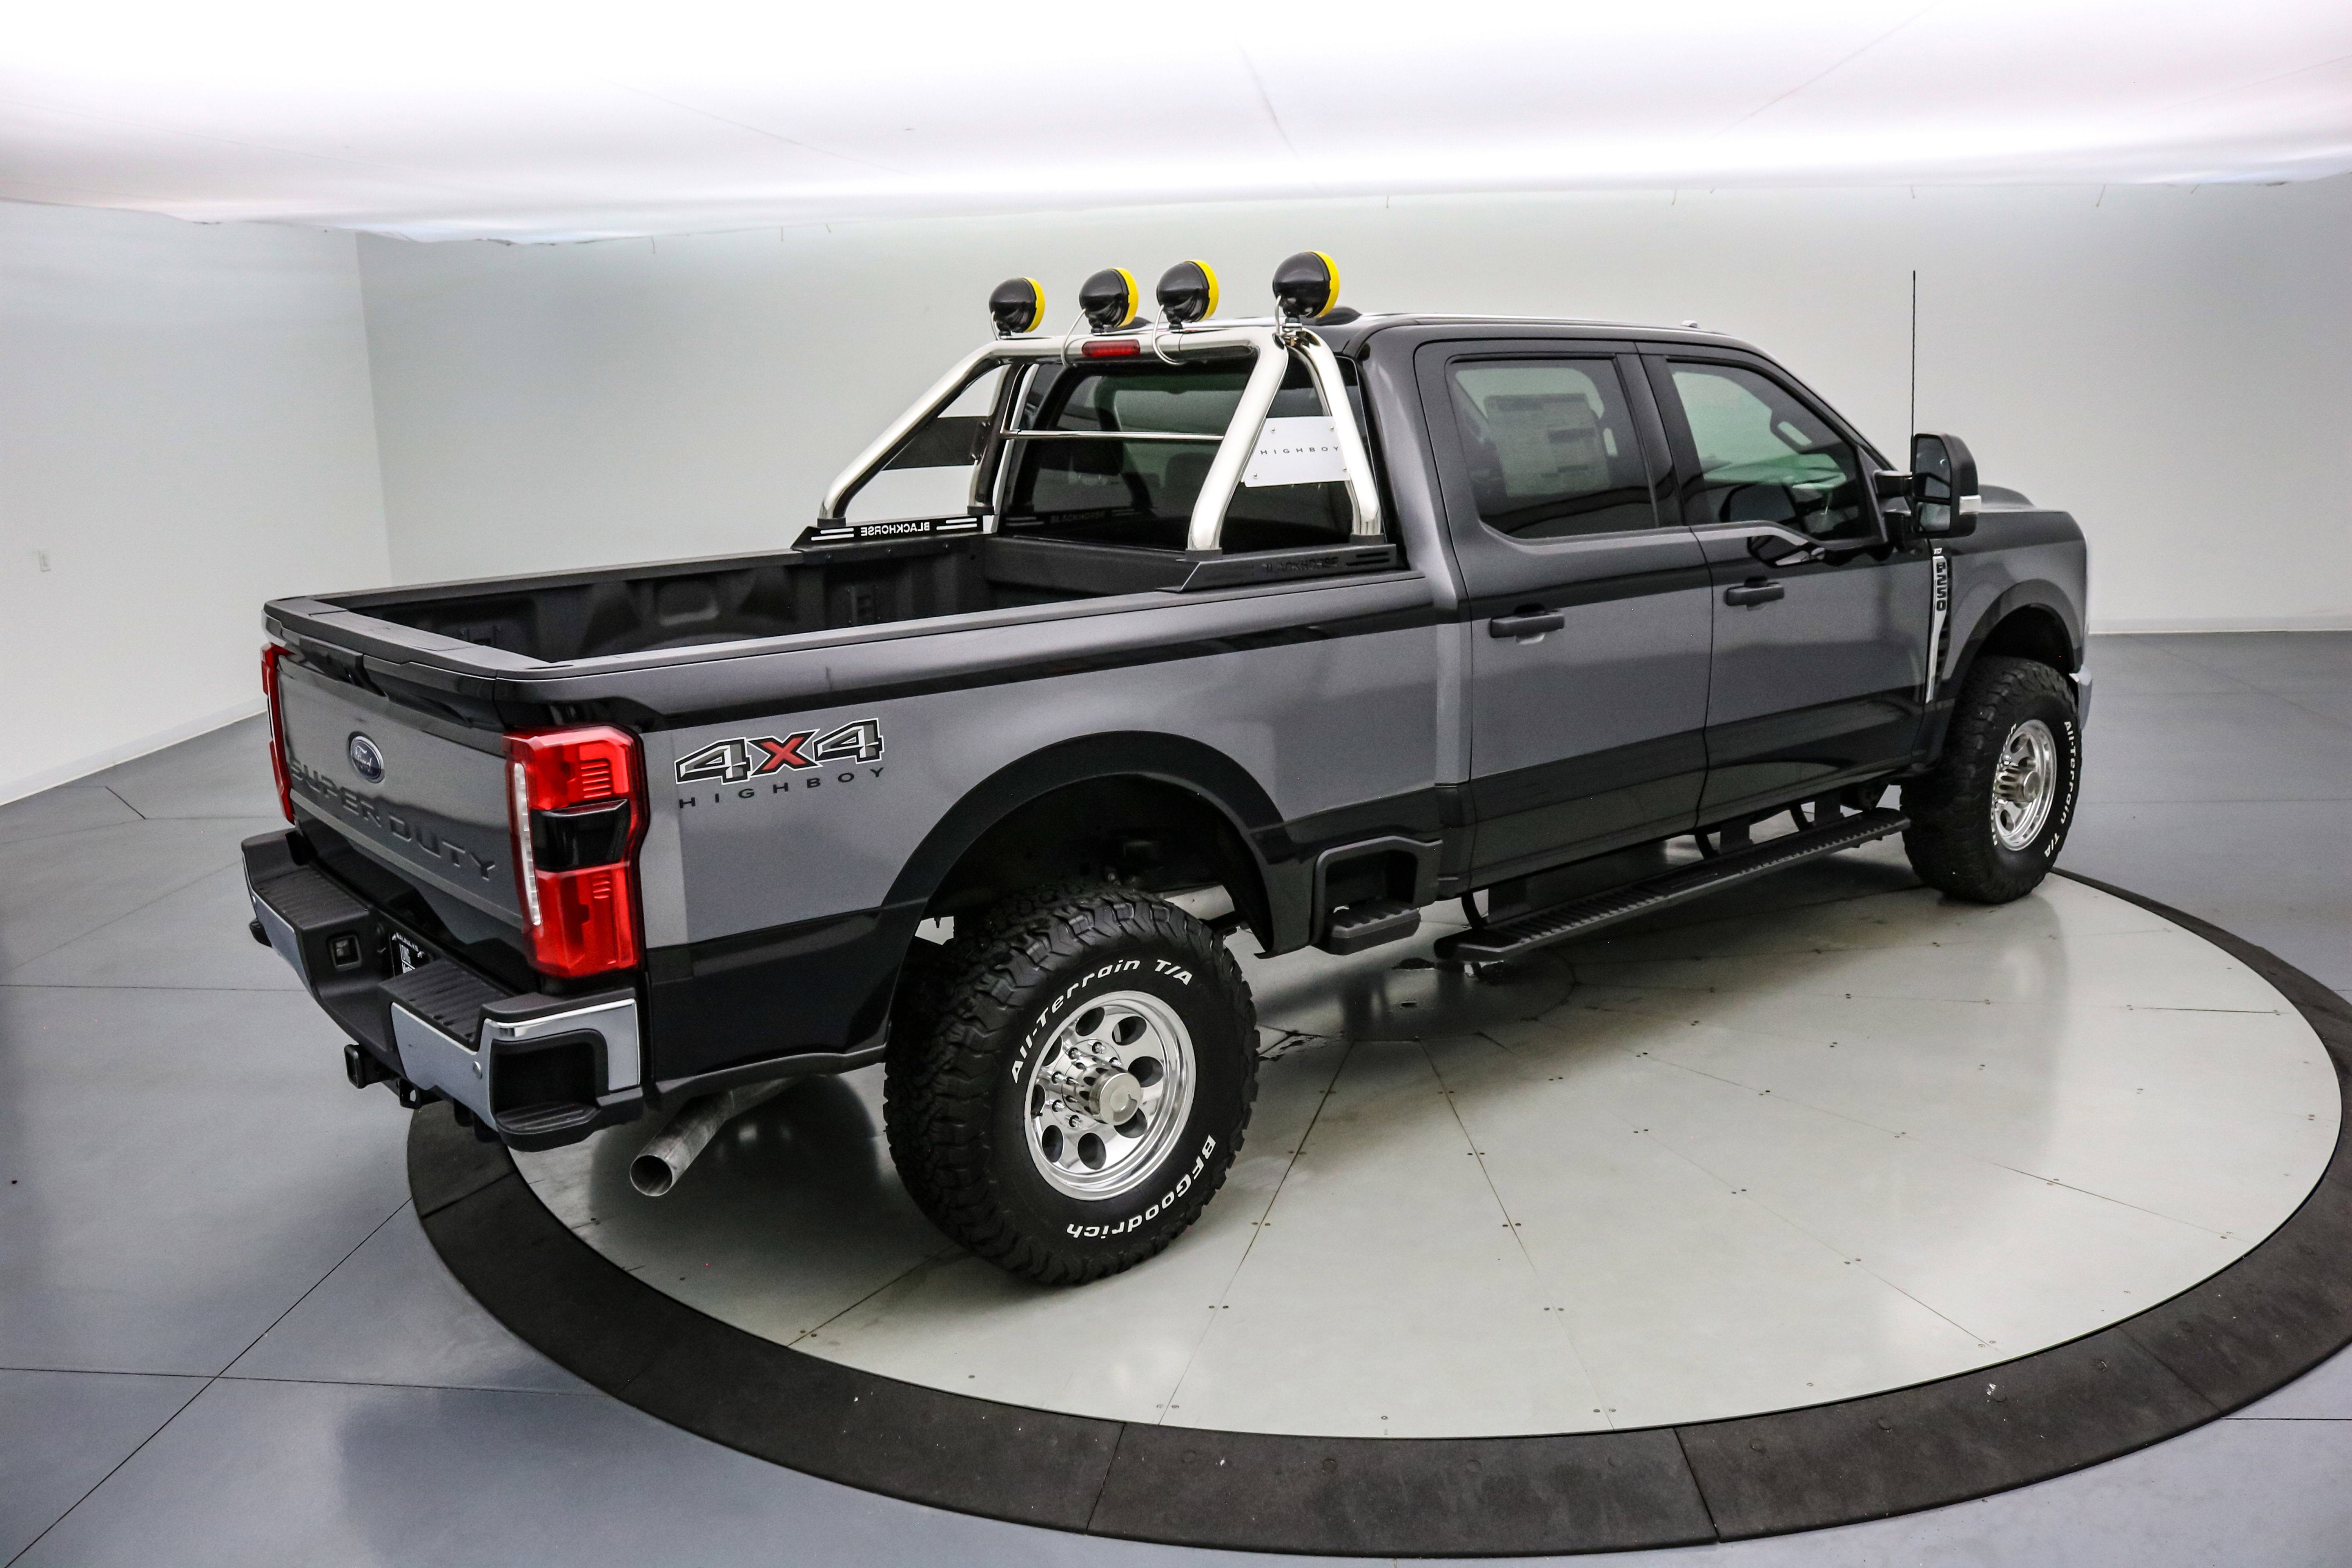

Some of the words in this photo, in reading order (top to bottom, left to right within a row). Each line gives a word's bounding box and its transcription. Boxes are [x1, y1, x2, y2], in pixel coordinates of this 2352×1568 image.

[1261, 446, 1339, 455] HIGHBOY
[355, 745, 372, 771] Ford
[679, 767, 883, 808] HIGHBOY
[290, 758, 382, 828] SUPER
[388, 813, 495, 881] DUTY
[1011, 958, 1140, 1083] All-Terrain
[1155, 958, 1193, 985] T/A
[1066, 1134, 1216, 1240] BFGoodrich
